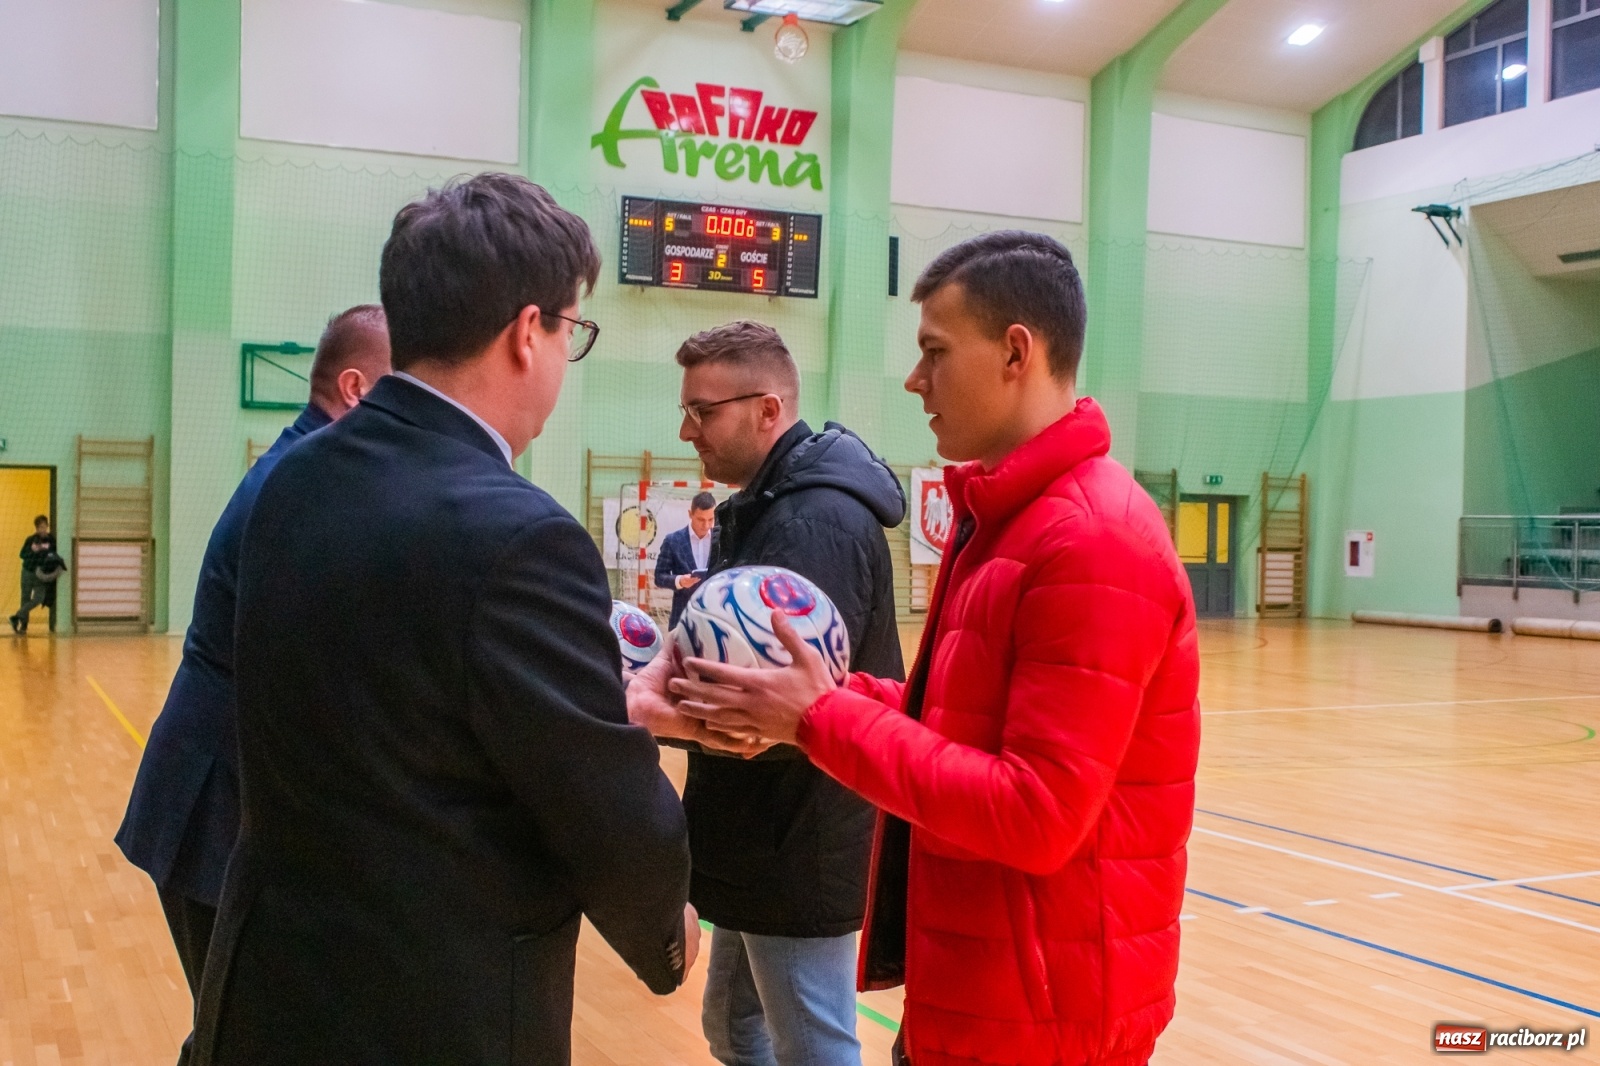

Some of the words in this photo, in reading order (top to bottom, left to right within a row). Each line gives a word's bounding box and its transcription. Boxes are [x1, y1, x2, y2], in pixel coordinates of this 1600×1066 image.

[640, 82, 818, 146] RAFAKO
[591, 76, 823, 191] Arena
[664, 216, 675, 232] 5
[771, 227, 781, 241] 3
[664, 244, 715, 260] GOSPODARZE
[740, 249, 769, 264] GOŚCIE
[716, 253, 727, 268] 2
[670, 262, 682, 281] 3
[752, 269, 764, 288] 5
